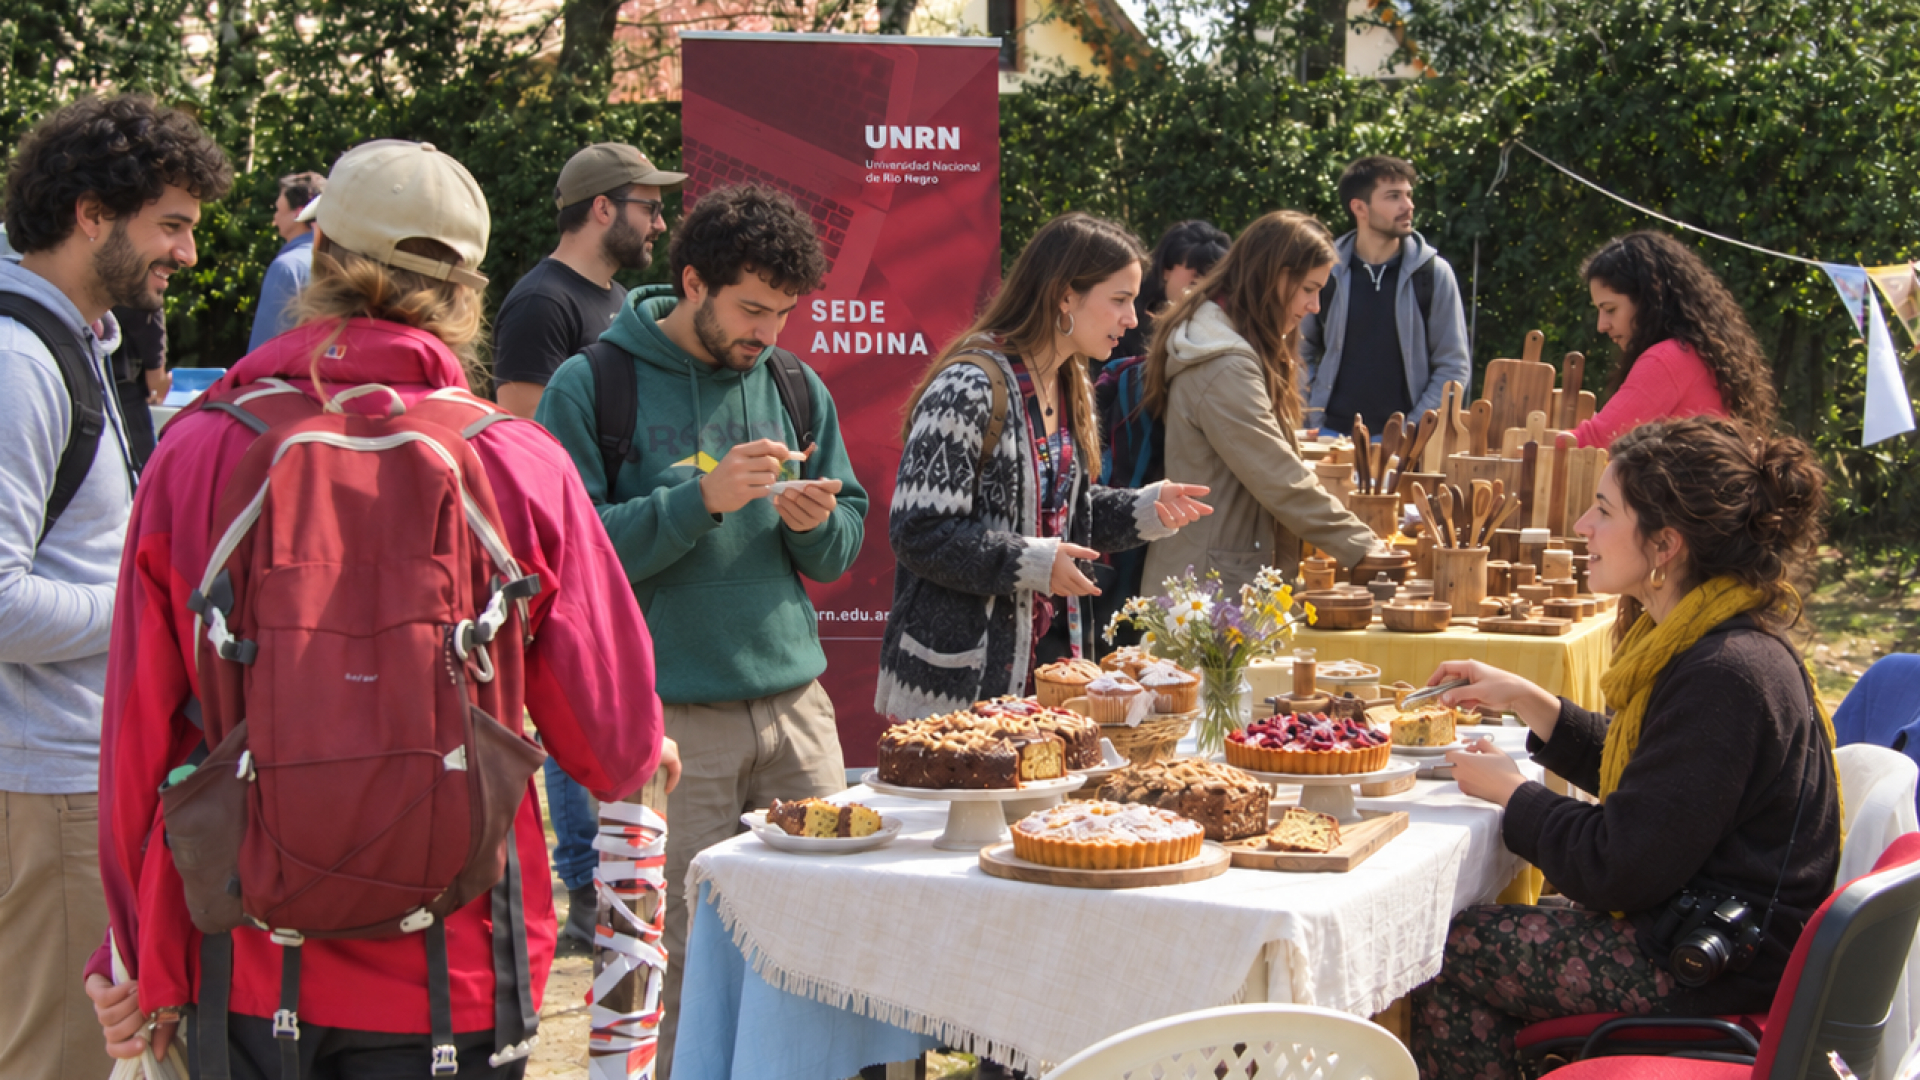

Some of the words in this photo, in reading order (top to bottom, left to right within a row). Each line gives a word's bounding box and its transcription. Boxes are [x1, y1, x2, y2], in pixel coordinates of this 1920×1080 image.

[865, 125, 960, 150] UNRN
[865, 160, 929, 171] Universidad
[932, 161, 981, 172] Nacional
[866, 173, 881, 183] de
[904, 174, 939, 186] Negro
[811, 299, 885, 323] SEDE
[810, 331, 929, 355] ANDINA
[819, 608, 891, 621] rn.edu.ar
